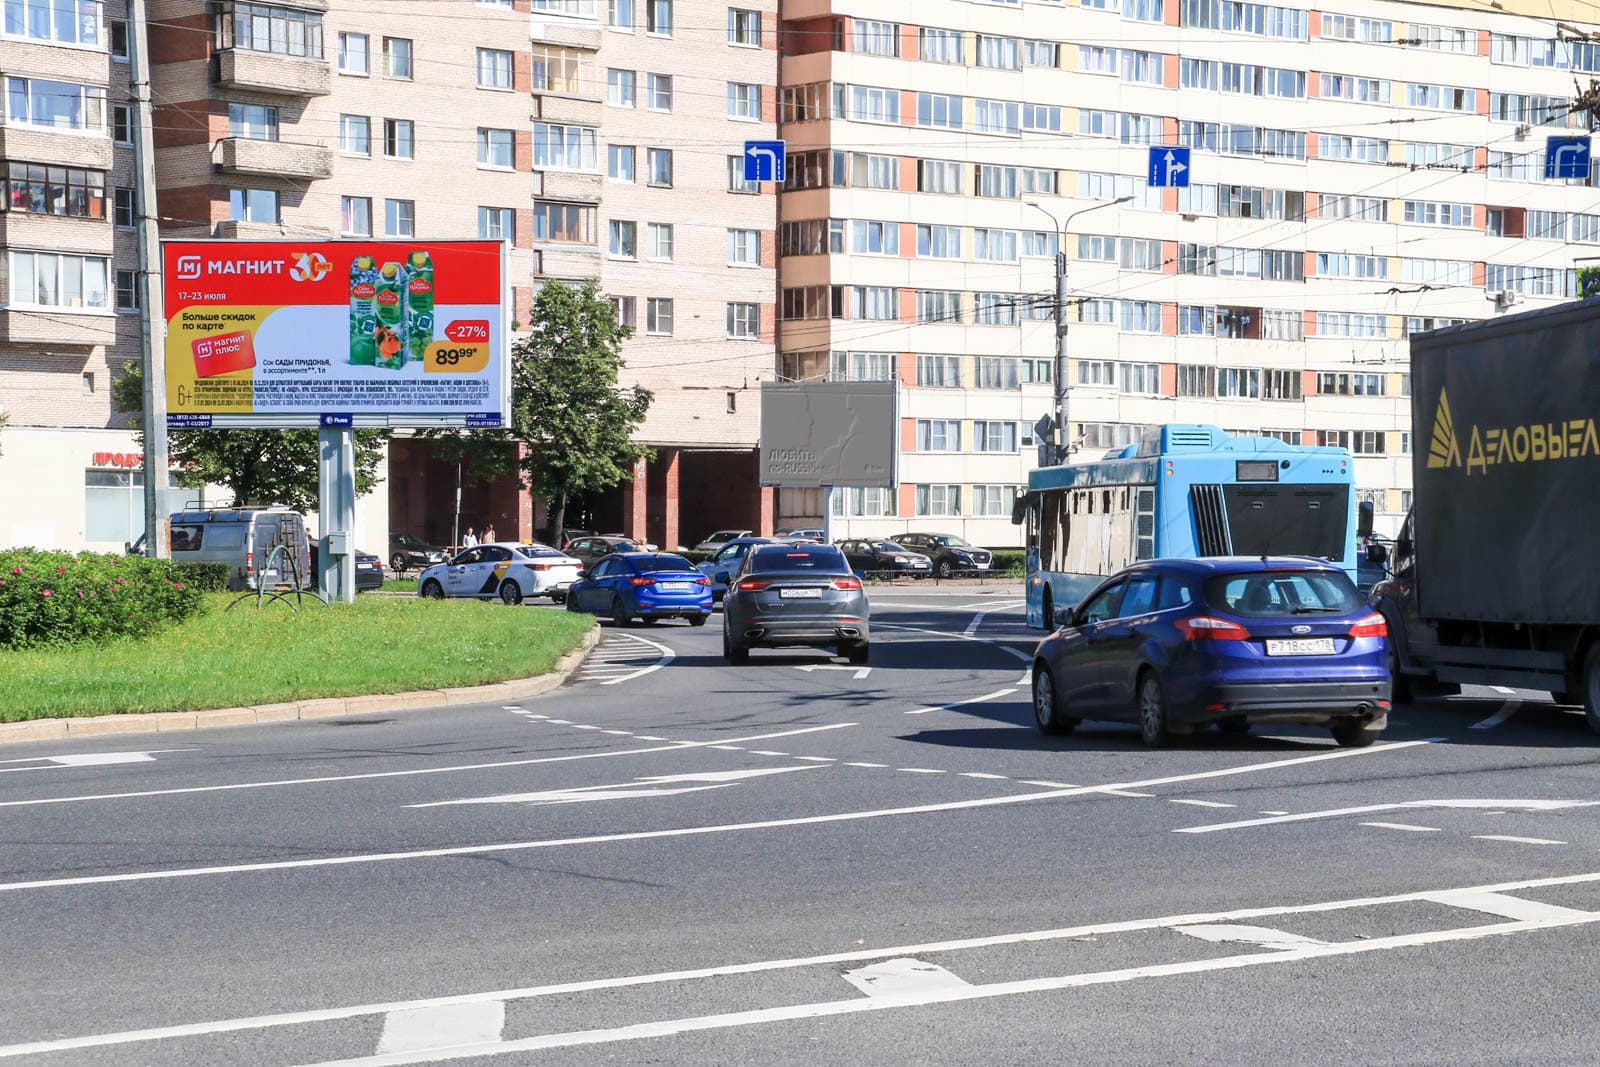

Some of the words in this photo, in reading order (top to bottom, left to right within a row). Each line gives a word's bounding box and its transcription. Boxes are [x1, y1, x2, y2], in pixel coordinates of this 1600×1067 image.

[207, 260, 285, 275] МАГНИТ
[289, 252, 328, 281] 30
[182, 312, 219, 321] Больше
[221, 313, 256, 322] скидок
[196, 323, 225, 331] карте
[214, 335, 246, 346] магнит
[215, 344, 241, 354] плюс
[275, 359, 294, 367] САДЫ
[295, 359, 332, 367] ПРИДОНЬЯ,
[177, 385, 192, 406] 6+
